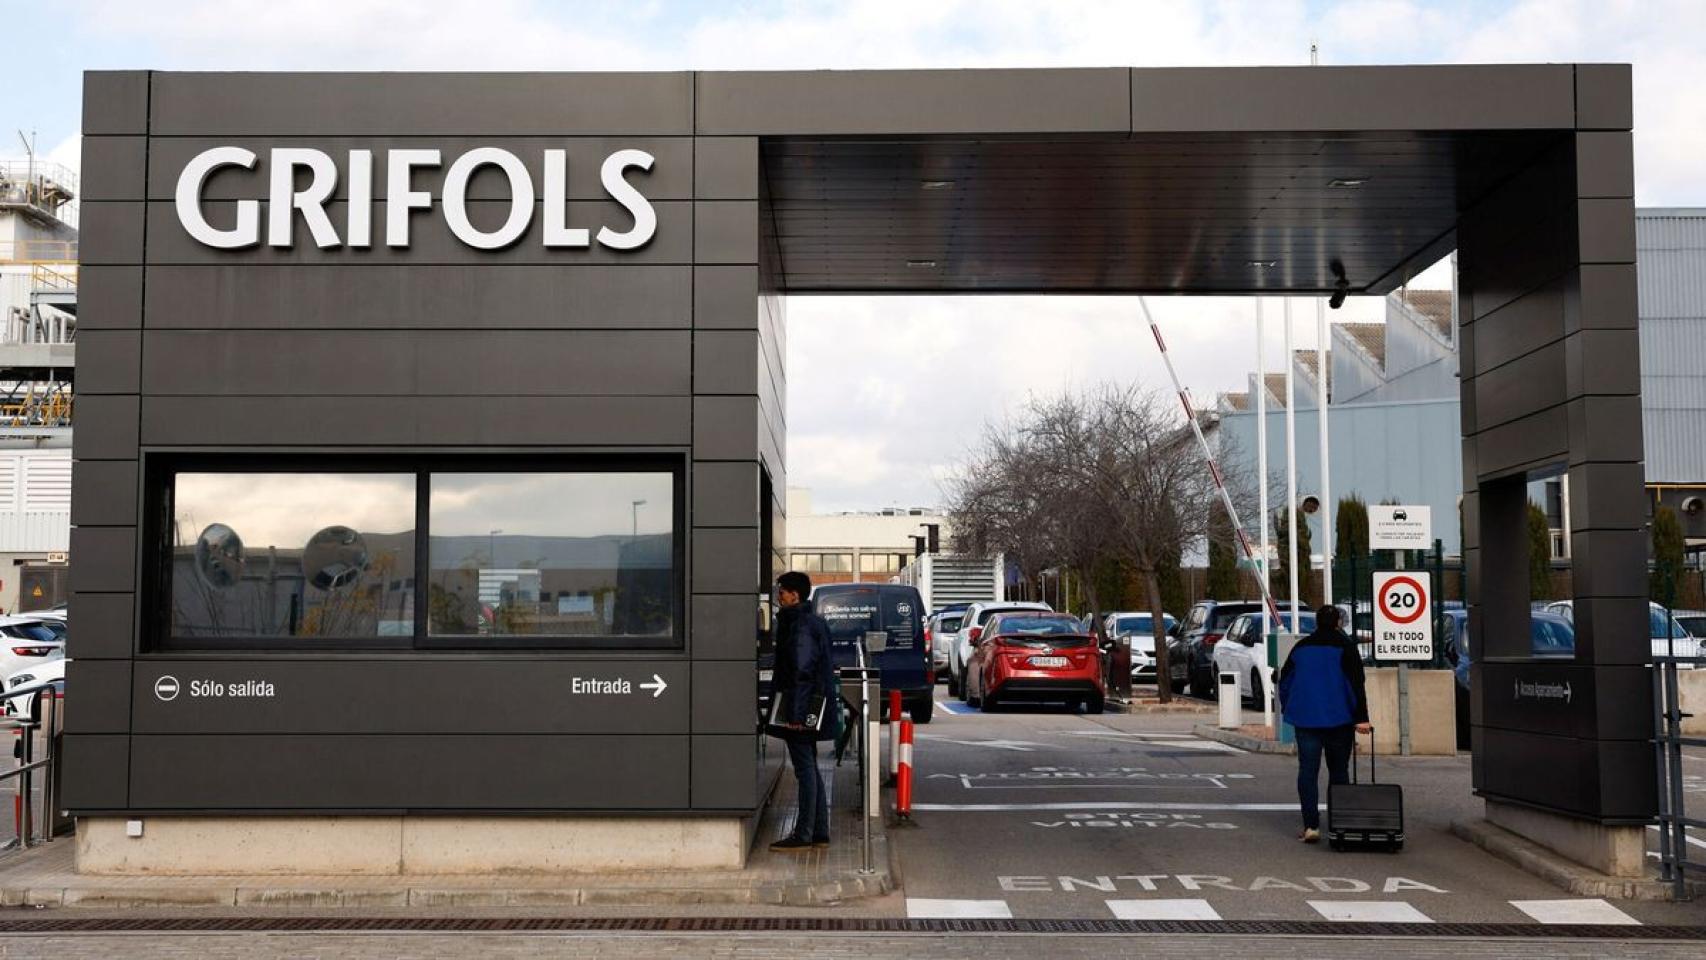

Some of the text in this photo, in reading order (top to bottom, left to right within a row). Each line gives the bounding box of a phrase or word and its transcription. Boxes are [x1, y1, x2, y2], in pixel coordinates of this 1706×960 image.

[175, 145, 659, 250] GRIFOLS
[1389, 592, 1416, 608] 20
[1383, 632, 1424, 640] EN TODO
[1377, 645, 1431, 654] EL RECINTO
[190, 680, 274, 697] Sólo salida
[572, 677, 631, 695] Entrada
[1030, 820, 1240, 830] VISITAS
[1064, 813, 1203, 821] STOP
[997, 874, 1453, 893] ENTRADA
